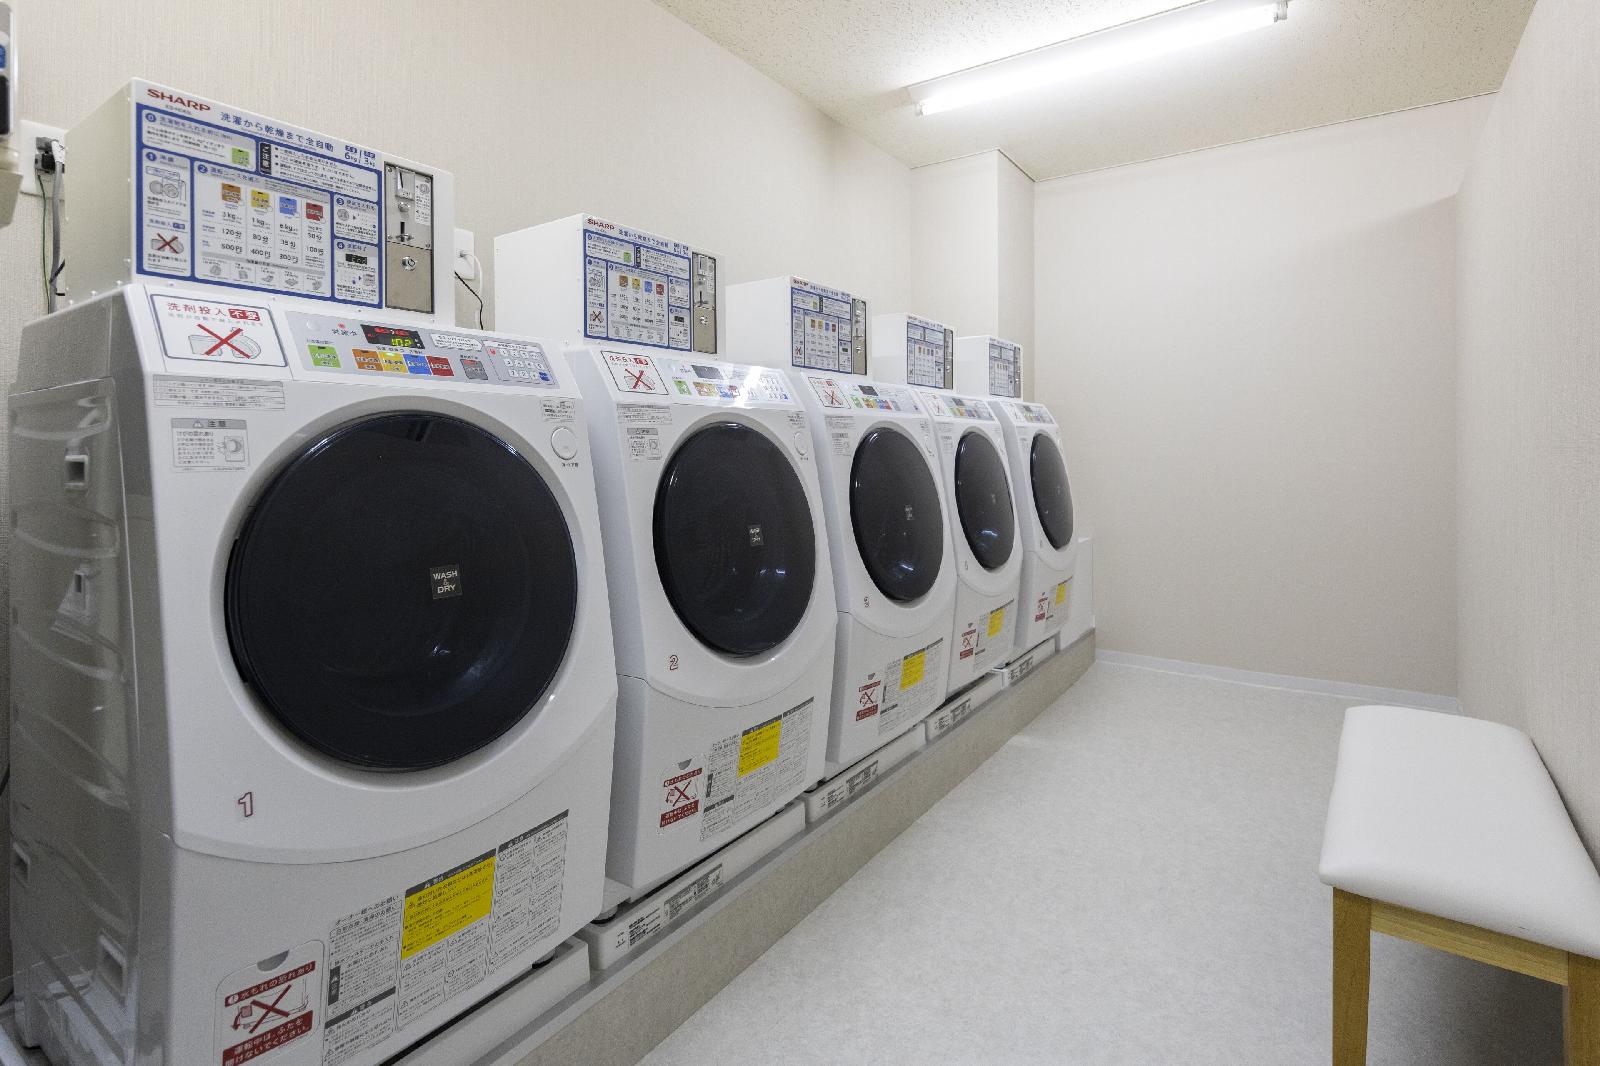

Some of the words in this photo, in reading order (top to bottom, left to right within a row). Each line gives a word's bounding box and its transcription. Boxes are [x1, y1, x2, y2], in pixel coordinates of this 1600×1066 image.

[147, 88, 211, 112] SHARP
[220, 111, 334, 154] 洗濯から乾燥まで全自動
[587, 218, 615, 230] SHARP
[433, 570, 457, 580] WASH
[437, 585, 456, 594] DRY
[669, 654, 679, 671] 2
[238, 791, 253, 817] 1
